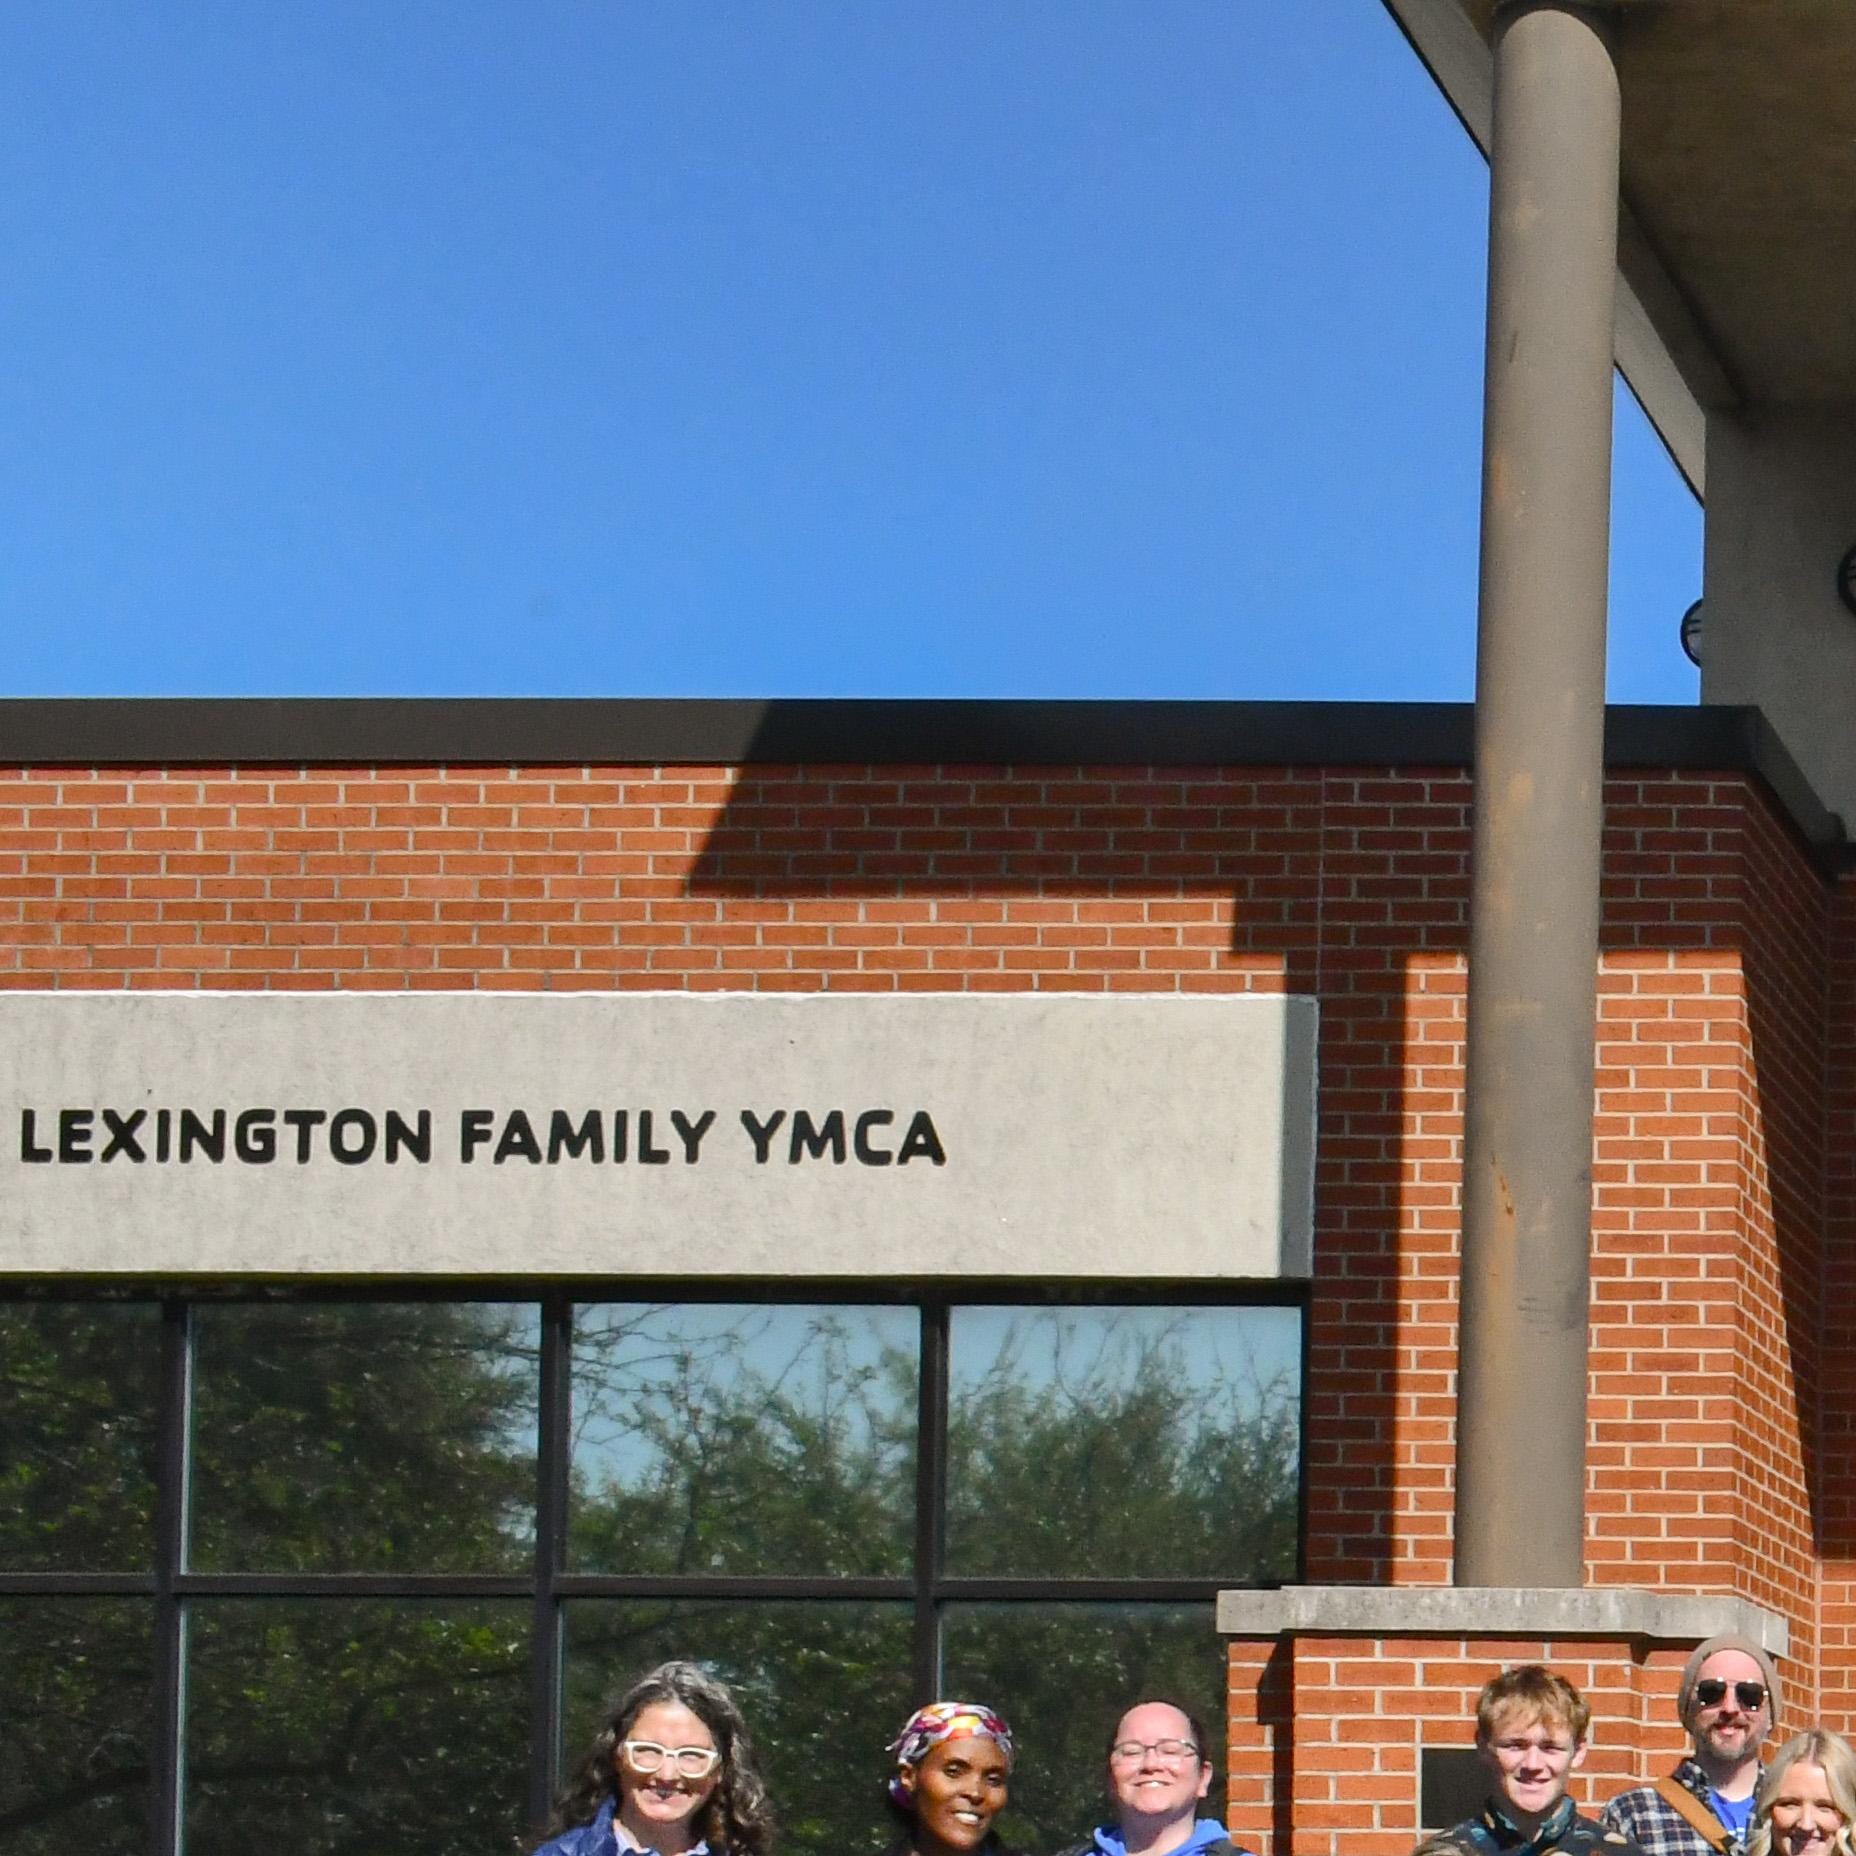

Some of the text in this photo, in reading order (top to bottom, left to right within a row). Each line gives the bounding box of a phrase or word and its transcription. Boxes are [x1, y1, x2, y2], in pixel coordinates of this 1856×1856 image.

[20, 1108, 948, 1166] LEXINGTON FAMILY YMCA
